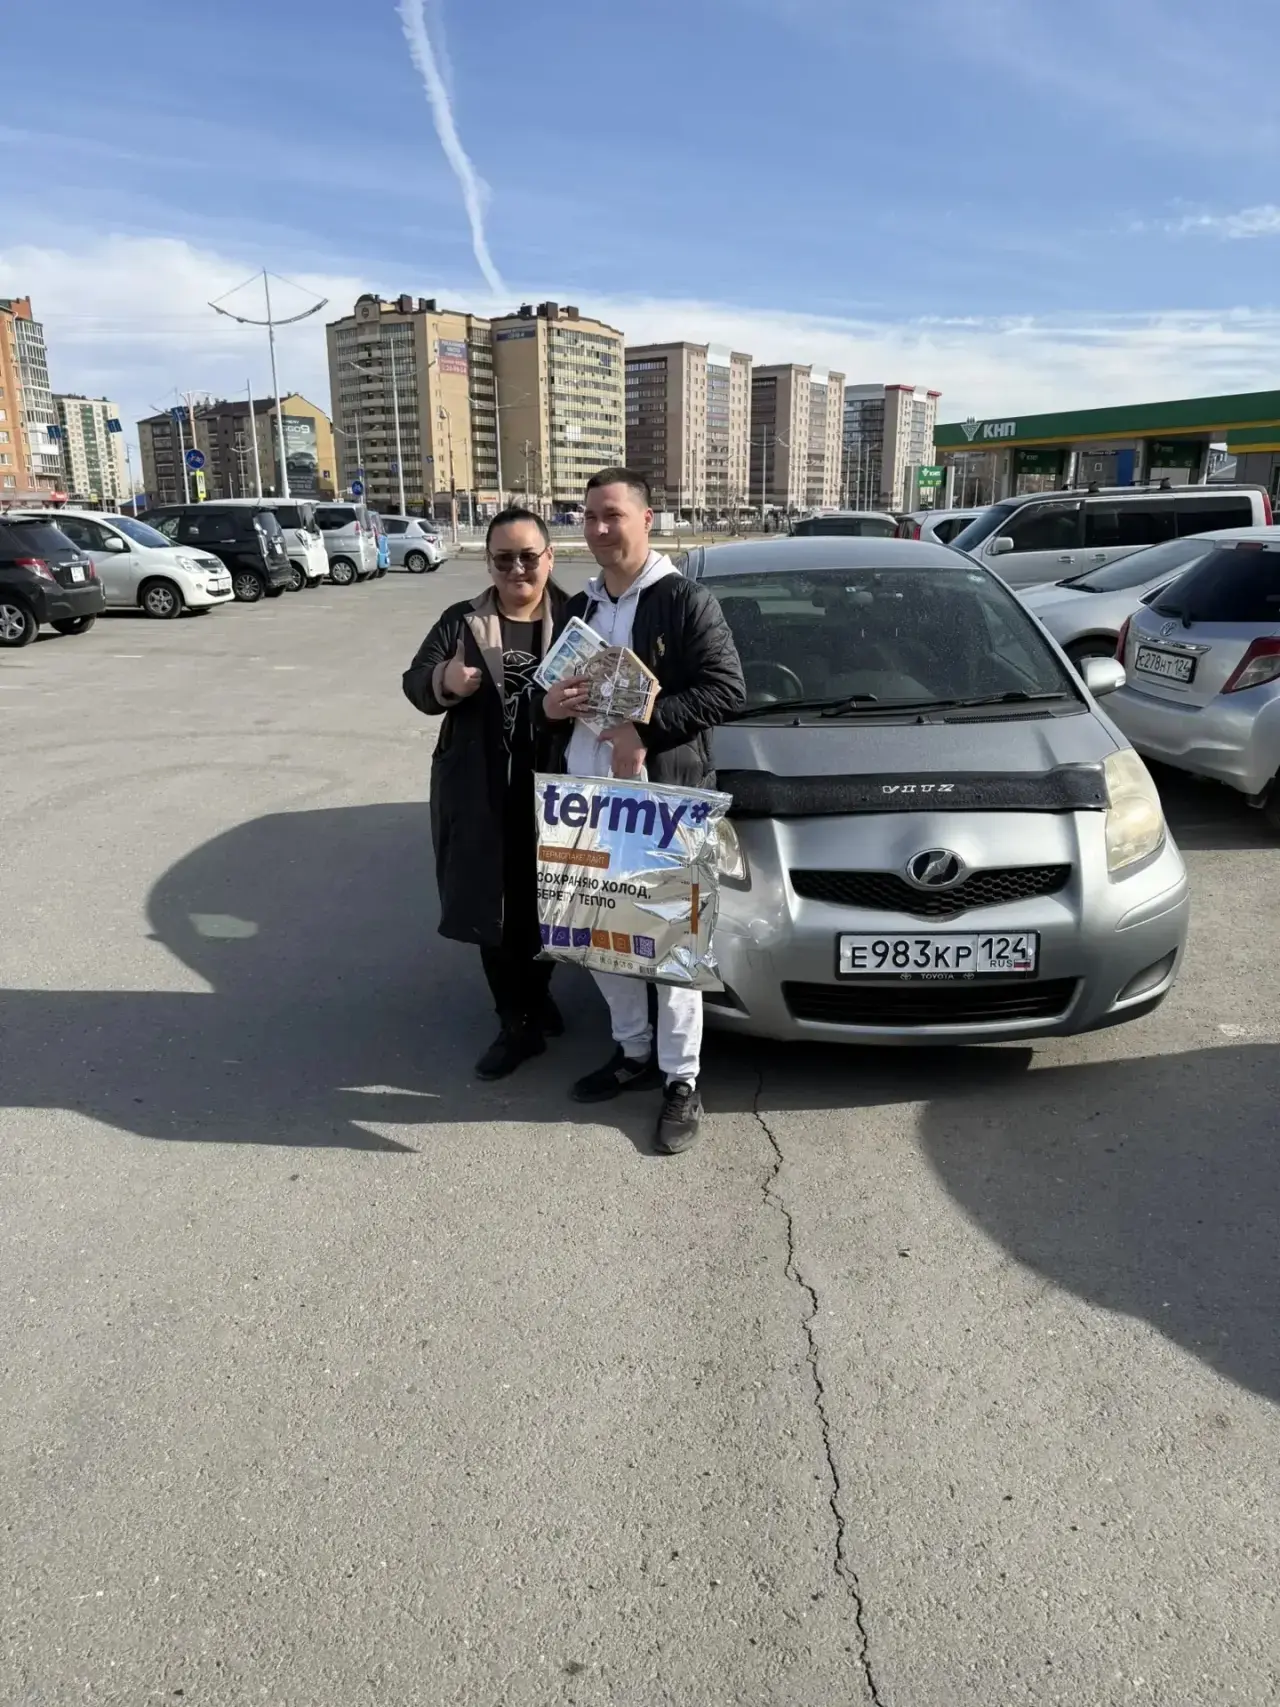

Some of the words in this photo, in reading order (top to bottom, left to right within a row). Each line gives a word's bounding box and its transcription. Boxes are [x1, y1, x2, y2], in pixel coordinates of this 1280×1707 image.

[983, 421, 1017, 438] КНП
[542, 784, 687, 849] termy
[537, 872, 599, 890] СОХРАНЯЮ
[601, 880, 652, 899] ХОЛОД,
[578, 893, 616, 909] ТЕПЛО
[981, 937, 1027, 960] 124
[989, 959, 1013, 968] RUS
